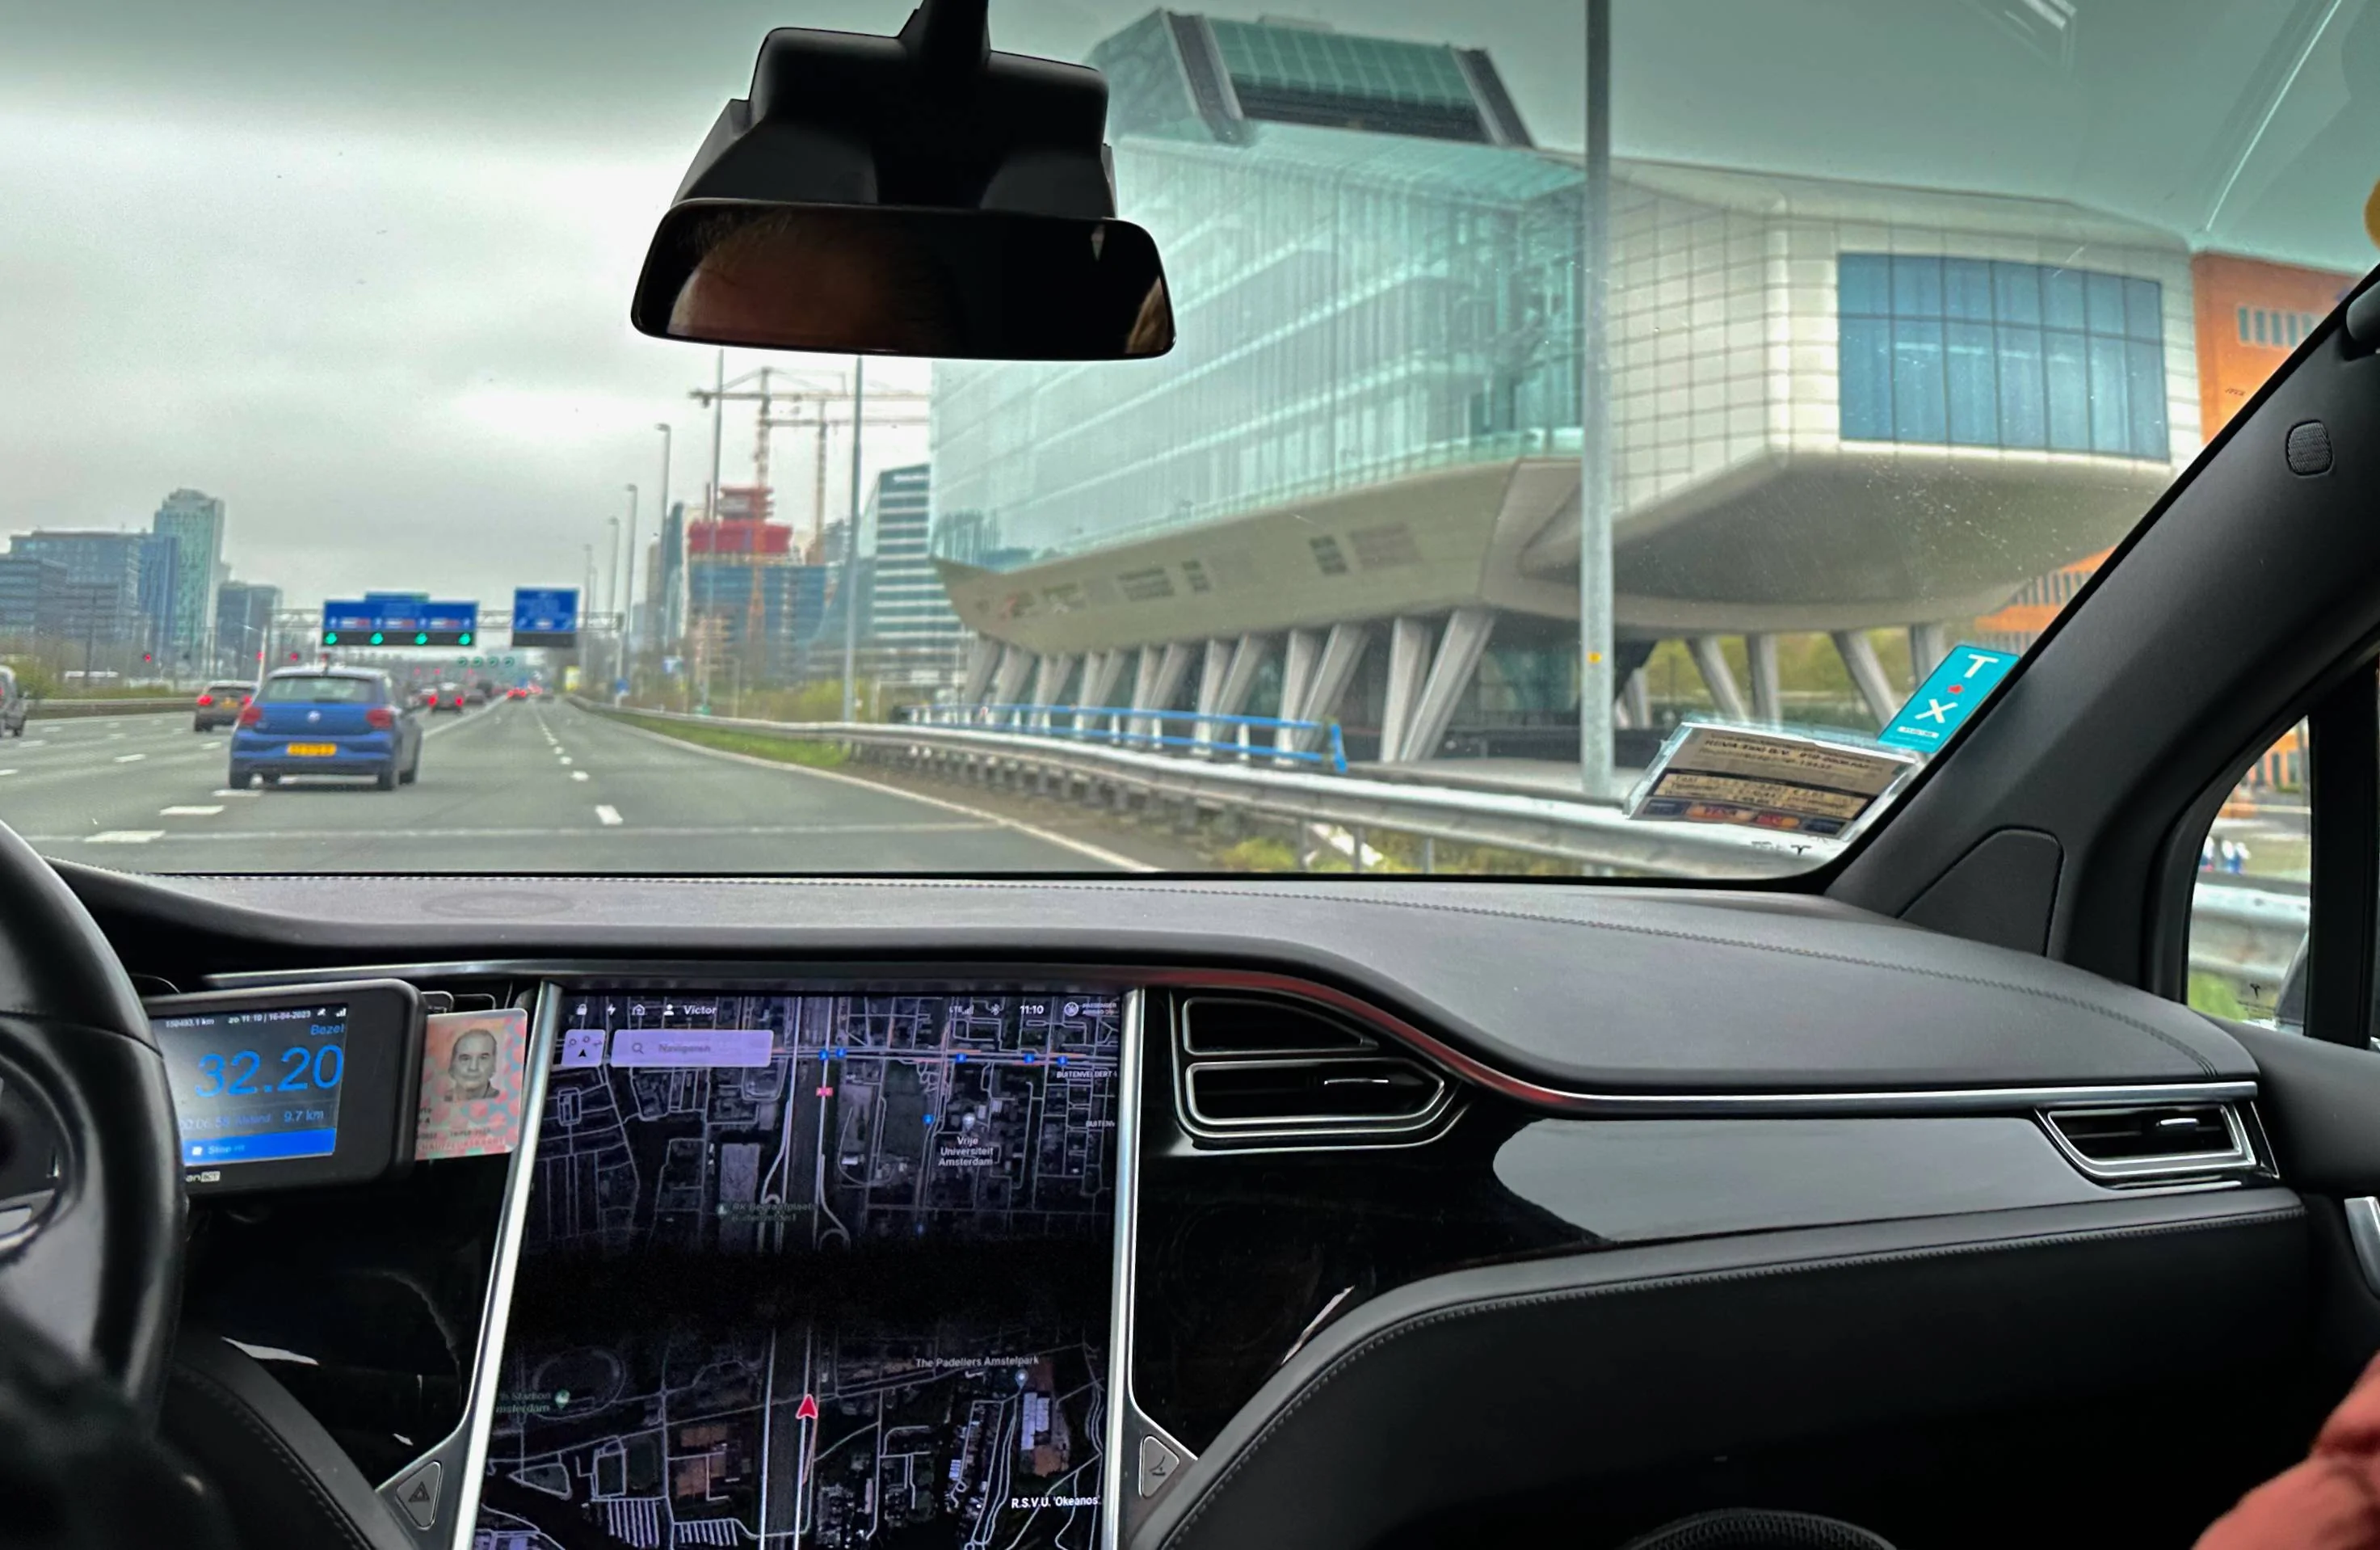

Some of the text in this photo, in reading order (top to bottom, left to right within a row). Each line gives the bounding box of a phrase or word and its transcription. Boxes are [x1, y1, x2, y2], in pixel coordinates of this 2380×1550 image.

[683, 1005, 717, 1015] Victor
[1020, 1005, 1045, 1015] 11:10
[194, 1044, 345, 1098] 32.20
[284, 1110, 304, 1123] 9.7
[305, 1109, 324, 1121] km
[957, 1135, 979, 1148] Vrije
[940, 1147, 994, 1156] Universiteit
[937, 1157, 994, 1166] Amsterdam
[916, 1358, 934, 1368] The
[983, 1356, 1040, 1367] Amstelpark
